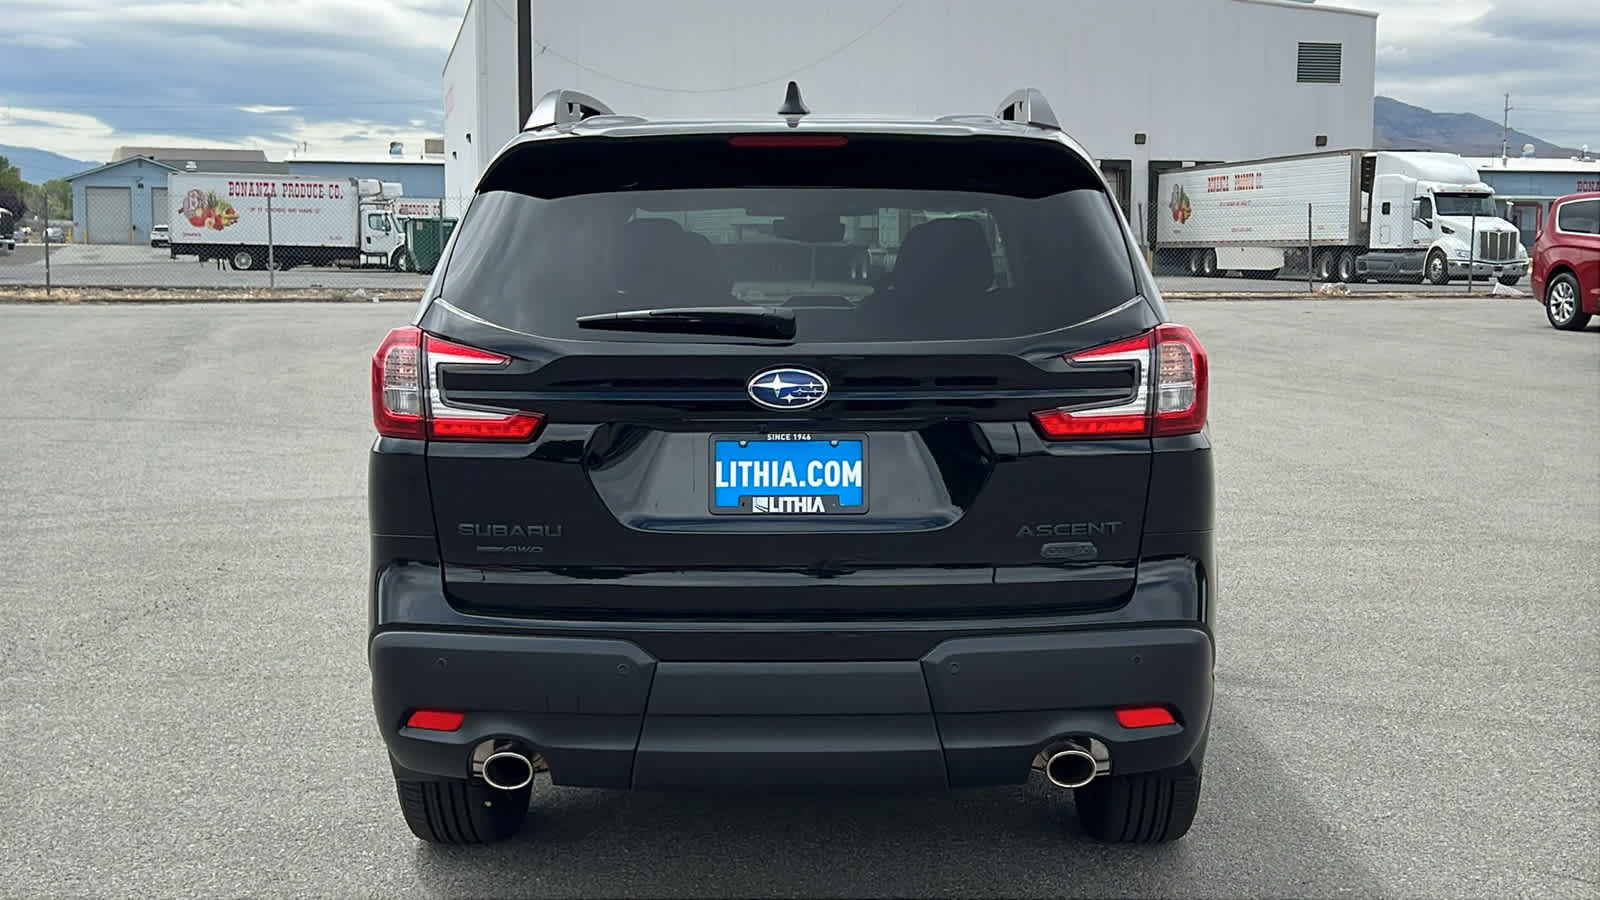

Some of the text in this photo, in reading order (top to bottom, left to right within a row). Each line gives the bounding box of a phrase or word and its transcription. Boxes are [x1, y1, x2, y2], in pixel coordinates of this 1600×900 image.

[228, 181, 344, 200] BONANZA PRODUCE CO.
[767, 433, 812, 441] SINCE 1946
[715, 460, 862, 488] LITHIA.COM
[769, 496, 825, 513] LITHIA
[457, 523, 562, 538] SUBARU
[1015, 521, 1123, 537] ASCENT
[502, 544, 544, 554] AWD
